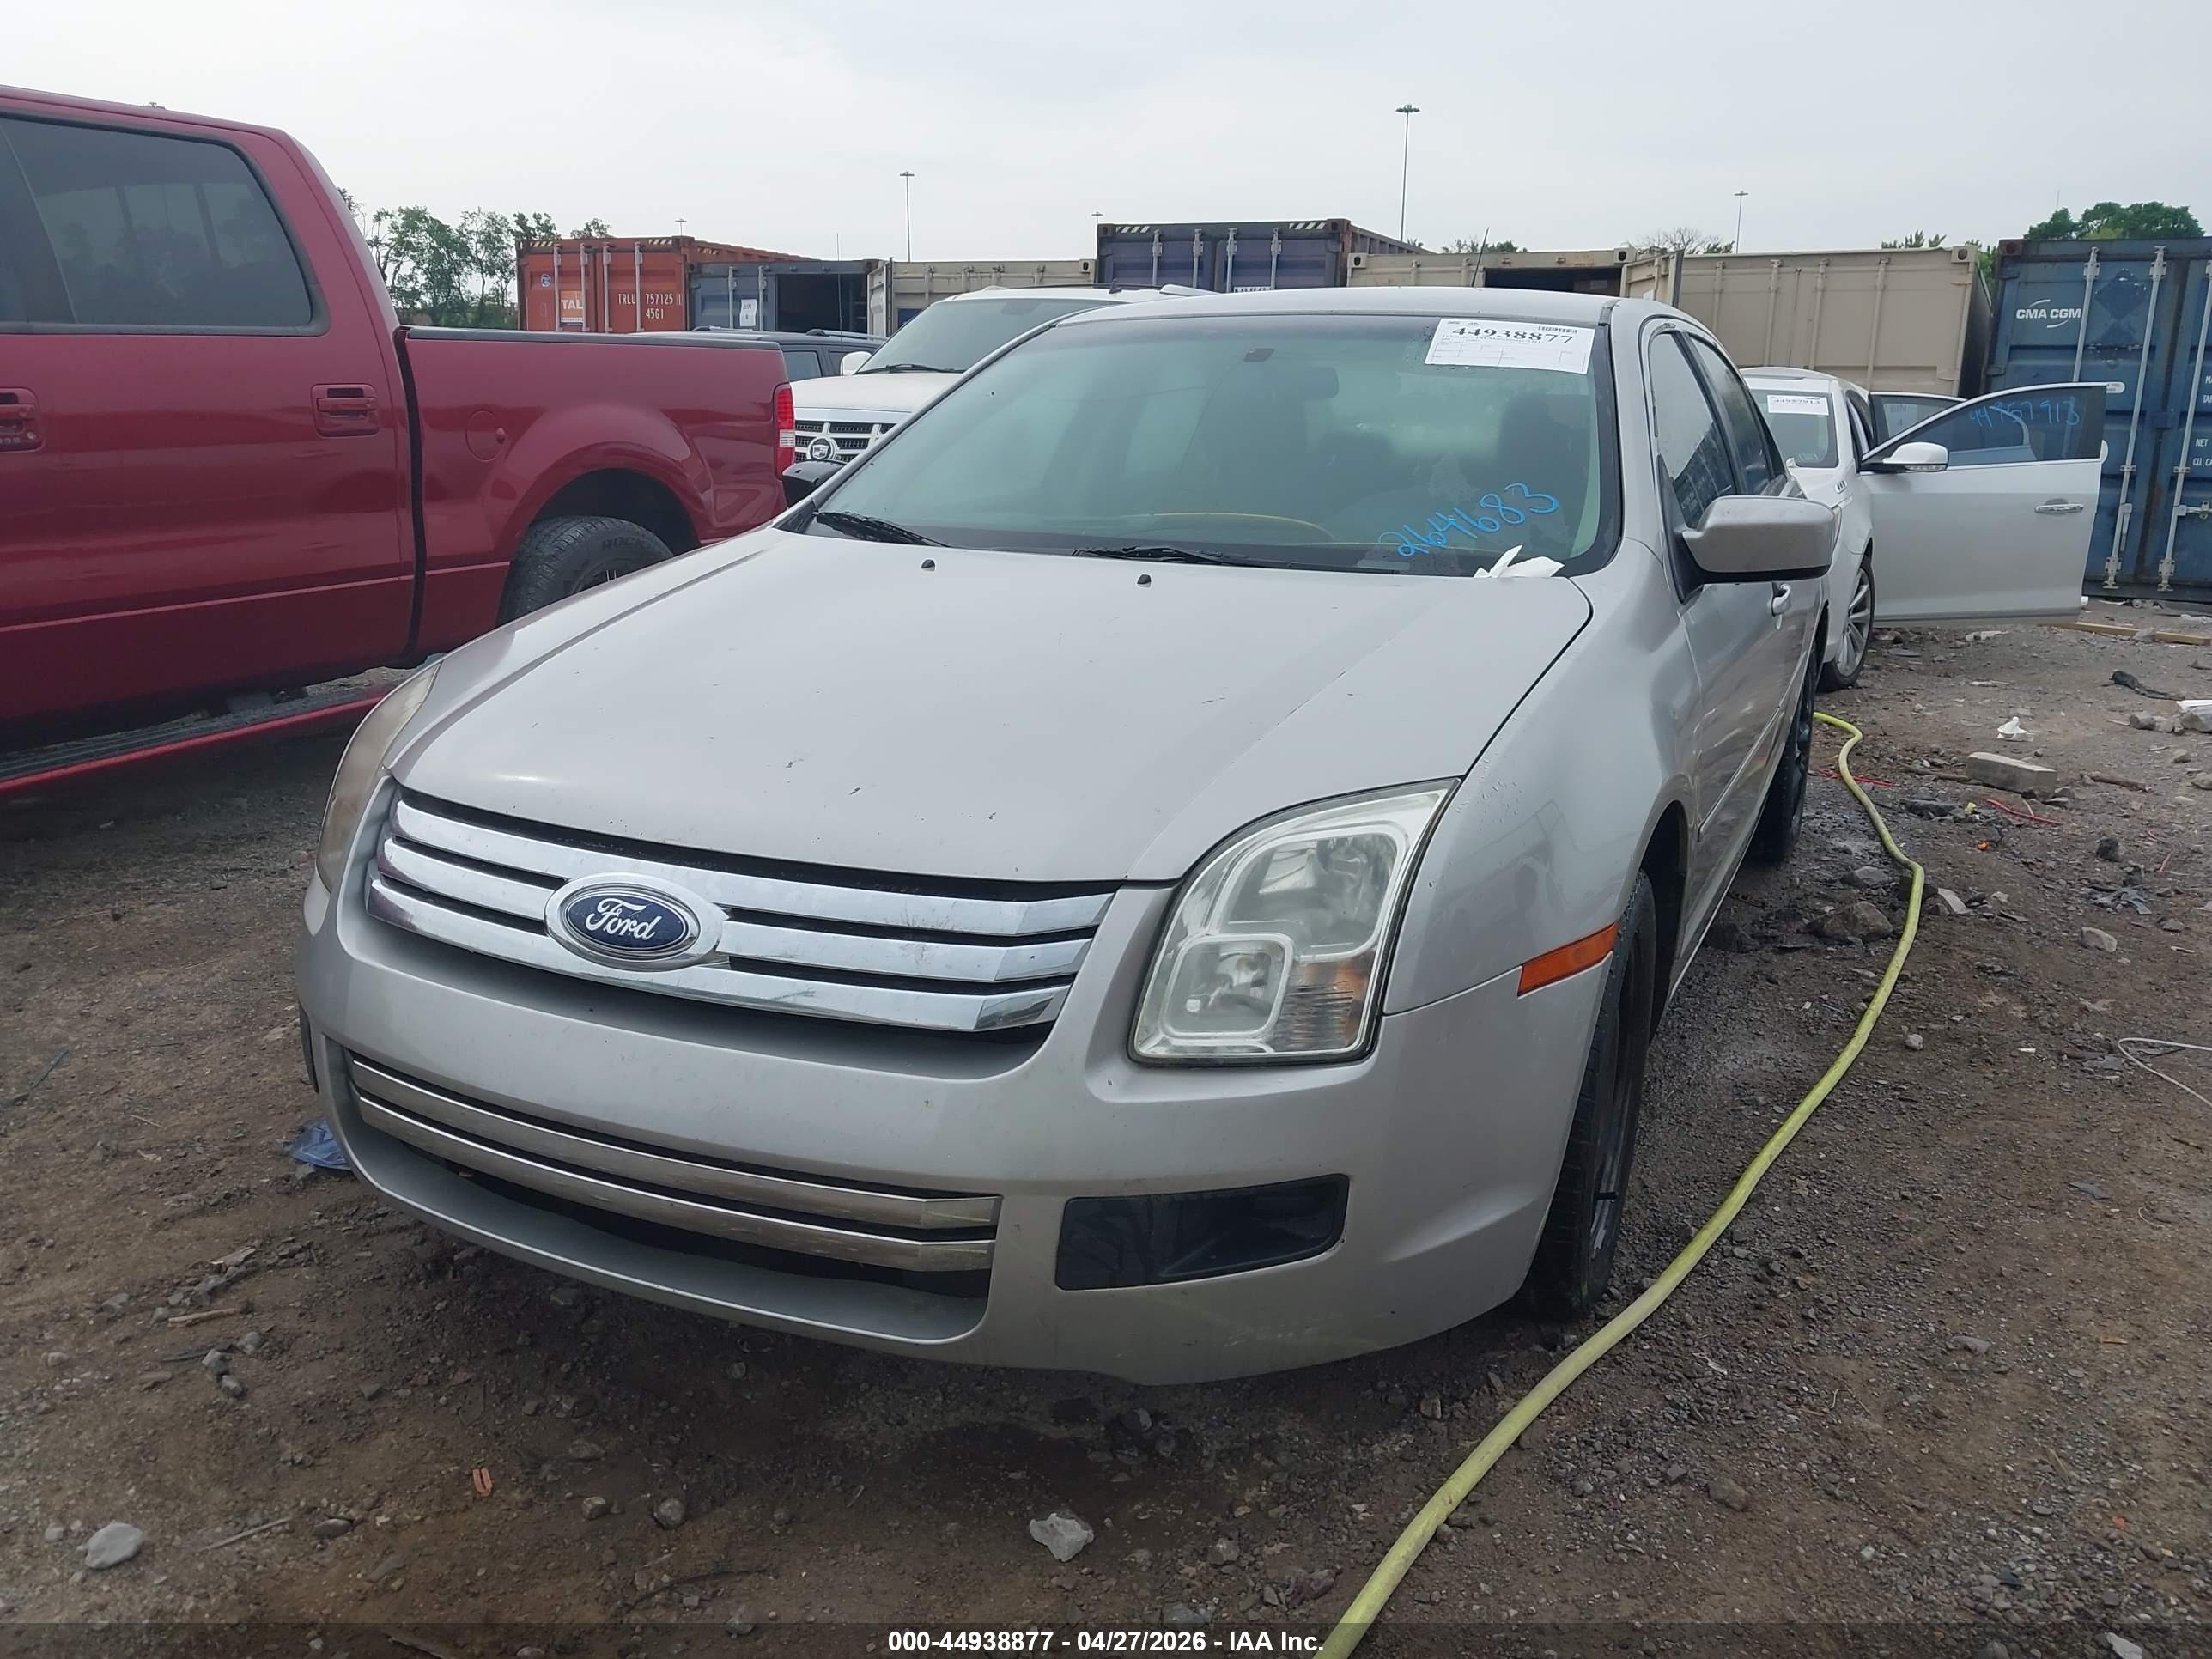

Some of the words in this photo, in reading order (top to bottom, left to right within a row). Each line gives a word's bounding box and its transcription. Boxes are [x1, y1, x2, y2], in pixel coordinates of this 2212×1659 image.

[561, 299, 584, 310] TAL
[617, 293, 636, 305] TRLU
[645, 293, 674, 305] 757125
[2015, 308, 2047, 319] CMA
[2049, 308, 2081, 319] CGM
[1452, 326, 1574, 343] 44938877
[1377, 483, 1559, 557] 2641683
[586, 898, 662, 941] Ford
